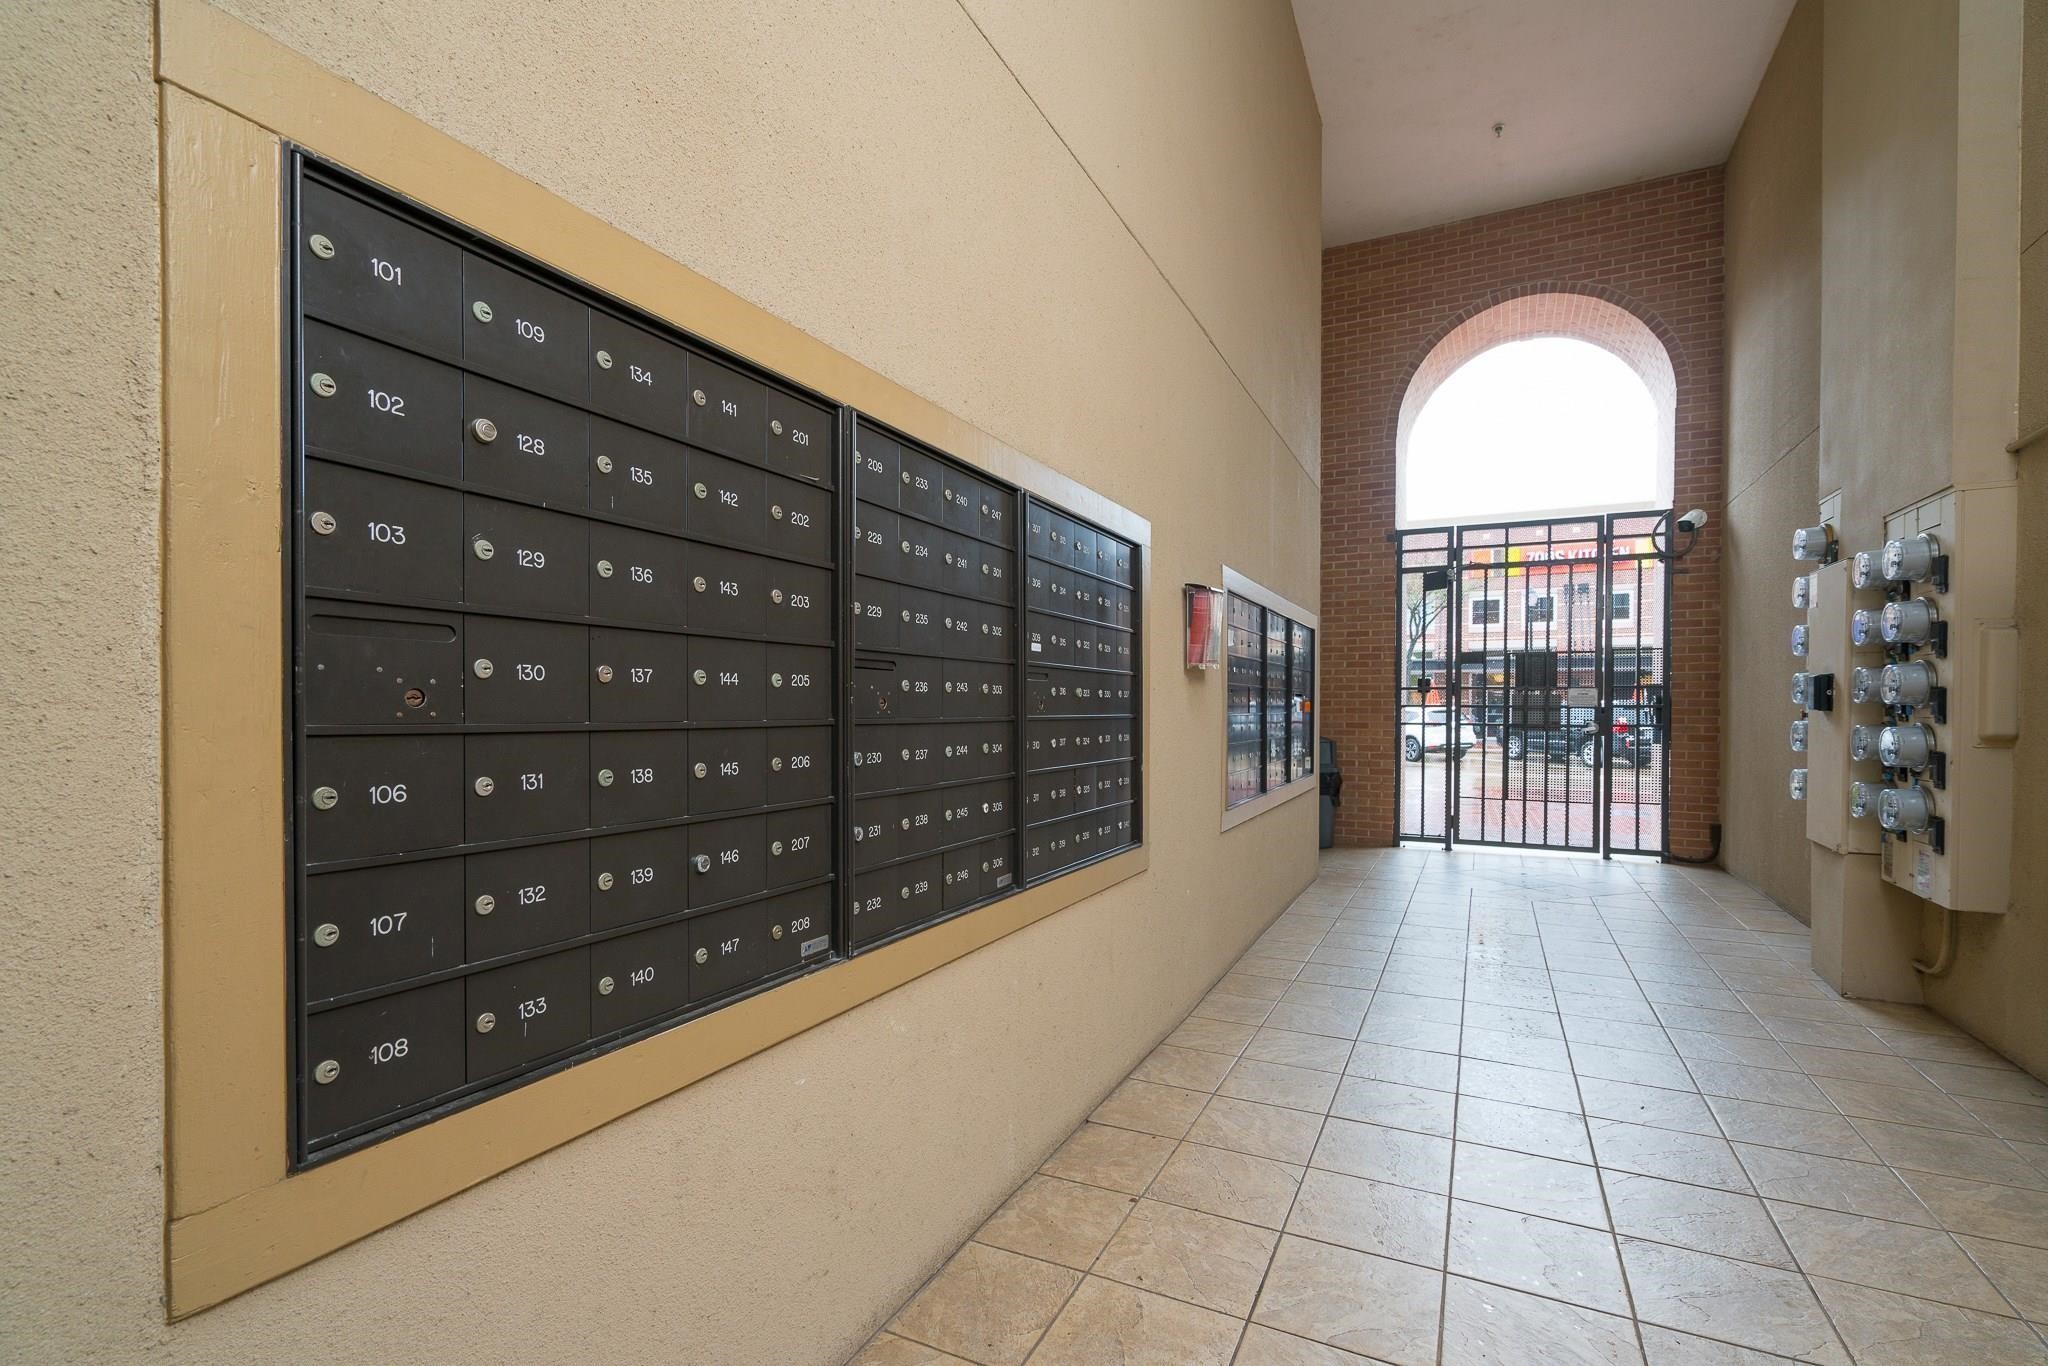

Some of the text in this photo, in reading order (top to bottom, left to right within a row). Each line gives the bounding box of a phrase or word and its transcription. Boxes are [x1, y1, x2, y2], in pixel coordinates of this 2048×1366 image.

[371, 258, 402, 286] 101
[515, 318, 545, 343] 109
[629, 365, 653, 386] 134
[367, 389, 405, 417] 102
[721, 399, 737, 417] 141
[516, 433, 545, 456] 128
[792, 429, 809, 446] 201
[867, 458, 883, 474] 209
[630, 466, 653, 486] 135
[915, 476, 929, 490] 233
[719, 489, 739, 507] 142
[956, 496, 968, 507] 240
[791, 511, 810, 528] 202
[991, 509, 1002, 521] 247
[367, 522, 406, 545] 103
[867, 530, 883, 545] 228
[915, 544, 928, 558] 234
[516, 549, 545, 569] 129
[957, 557, 967, 568] 241
[630, 566, 653, 584] 136
[992, 567, 1002, 578] 301
[719, 580, 739, 596] 143
[791, 594, 810, 609] 203
[867, 605, 882, 618] 229
[915, 613, 929, 625] 235
[956, 620, 968, 632] 242
[992, 625, 1002, 637] 302
[1032, 633, 1041, 642] 309
[516, 663, 546, 681] 130
[630, 668, 653, 683] 137
[719, 672, 739, 686] 144
[791, 674, 810, 687] 205
[915, 681, 928, 693] 236
[956, 682, 968, 693] 243
[992, 684, 1003, 695] 303
[915, 749, 928, 760] 237
[956, 745, 968, 756] 244
[991, 743, 1003, 753] 304
[791, 755, 810, 769] 206
[866, 752, 882, 764] 230
[630, 768, 653, 784] 138
[720, 761, 739, 776] 145
[520, 773, 543, 791] 131
[369, 784, 407, 805] 106
[956, 808, 968, 819] 245
[992, 801, 1003, 813] 305
[915, 814, 929, 826] 238
[868, 824, 881, 838] 231
[791, 836, 810, 851] 207
[720, 849, 739, 865] 146
[992, 858, 1003, 869] 306
[630, 867, 654, 885] 139
[957, 869, 969, 881] 246
[915, 880, 928, 894] 239
[518, 885, 546, 905] 132
[866, 896, 882, 911] 232
[370, 911, 407, 937] 107
[791, 916, 810, 933] 208
[720, 938, 740, 956] 147
[630, 966, 654, 987] 140
[518, 996, 547, 1020] 133
[371, 1038, 409, 1065] 108
